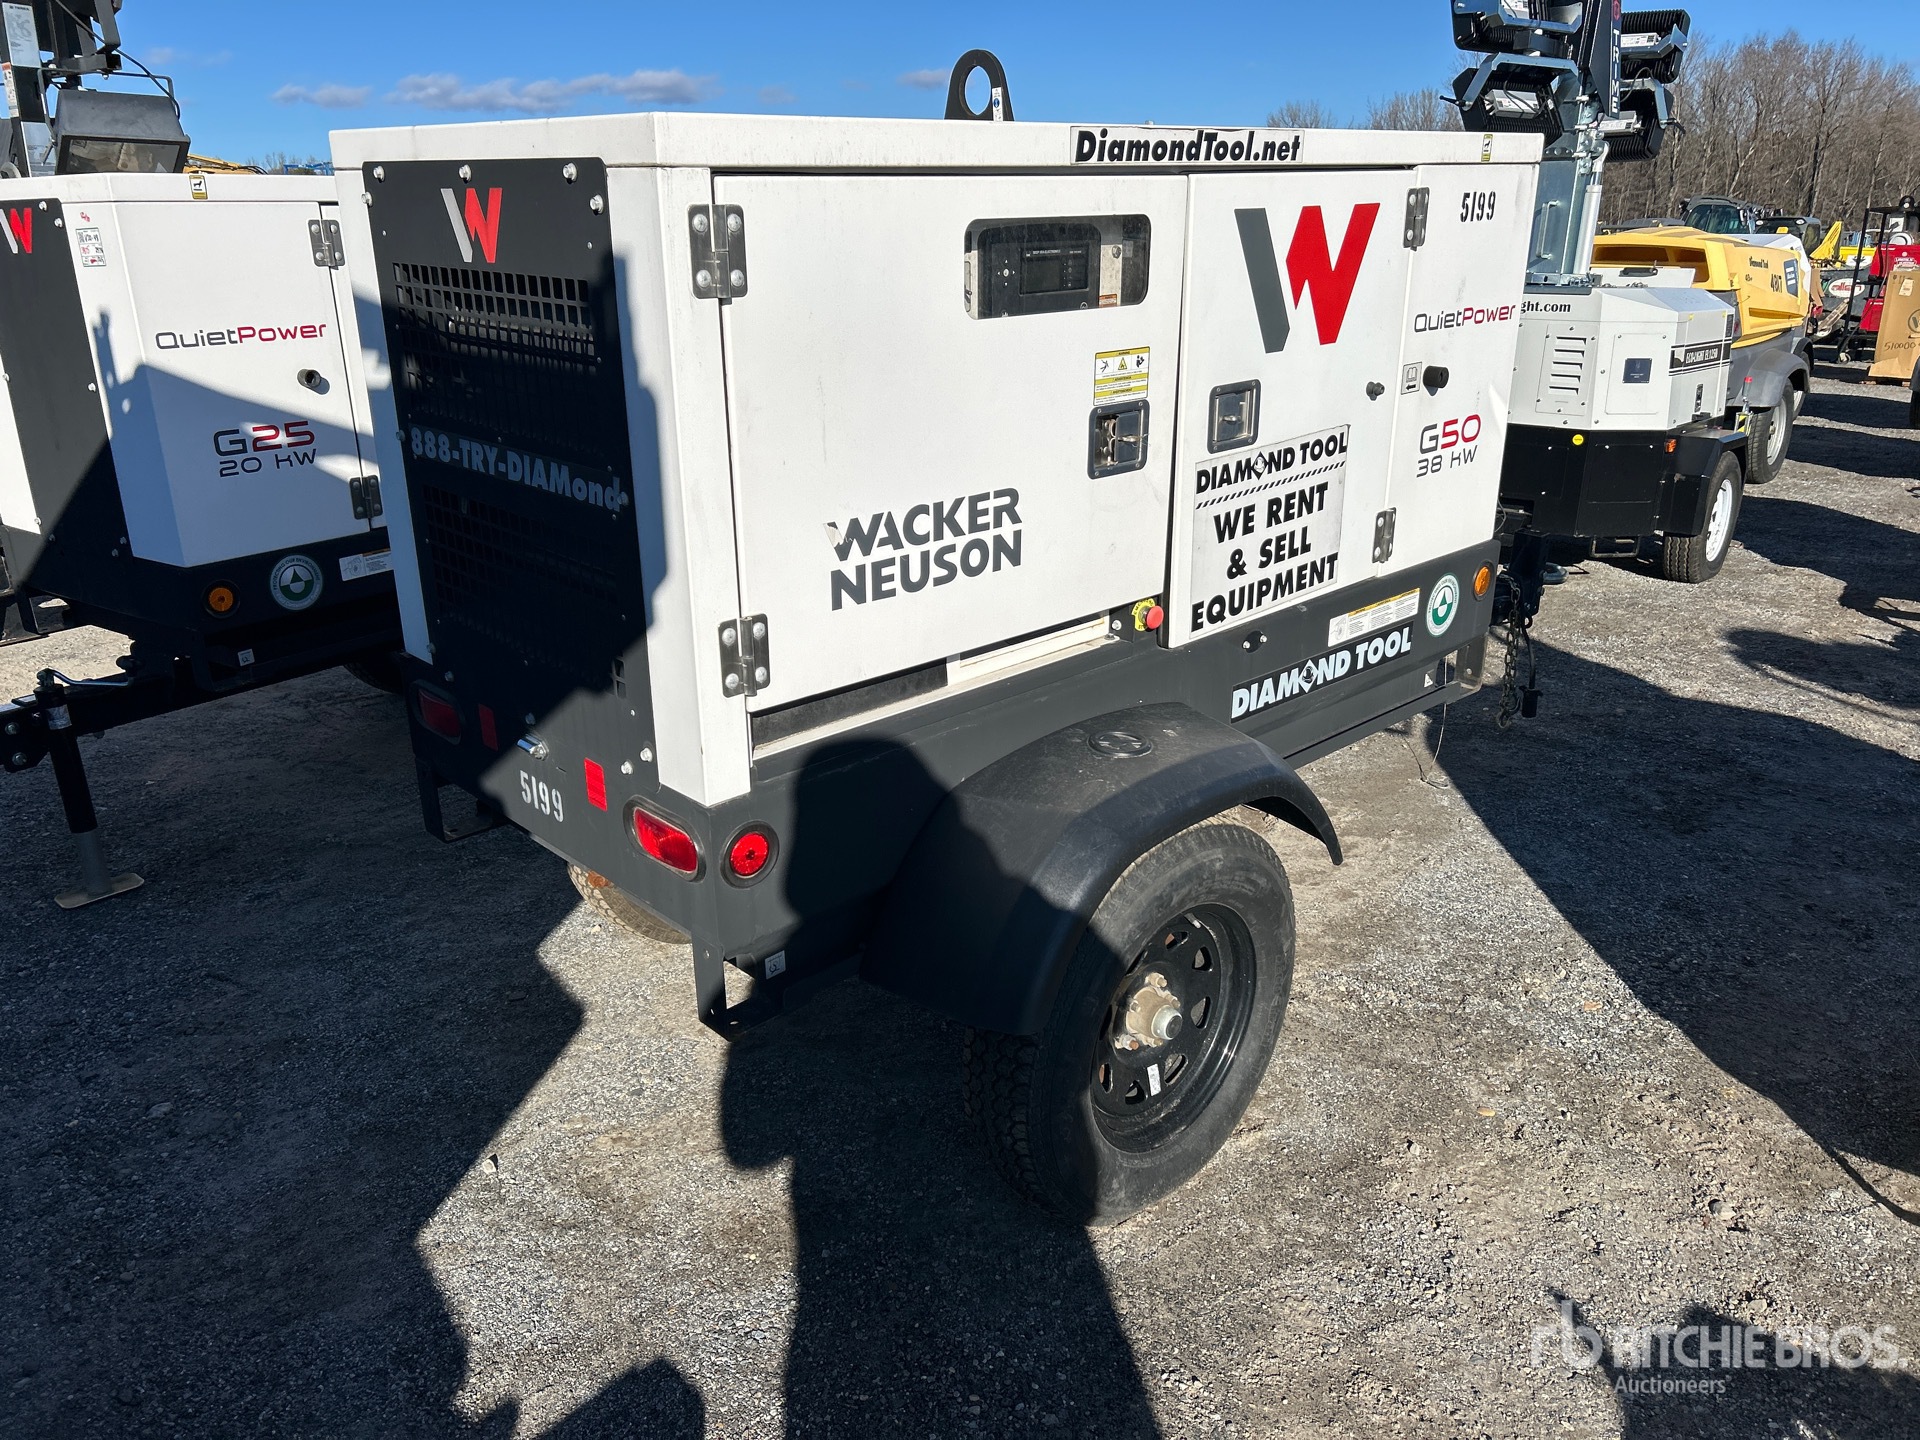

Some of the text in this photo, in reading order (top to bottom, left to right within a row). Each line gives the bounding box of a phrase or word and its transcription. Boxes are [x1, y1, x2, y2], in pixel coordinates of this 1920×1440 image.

[1611, 29, 1620, 113] TRIME
[1075, 128, 1301, 163] DiamondTool.net
[1460, 191, 1496, 222] 5199
[156, 322, 327, 350] QuietPower
[1414, 304, 1517, 333] QuietPower
[214, 420, 316, 457] G25
[1300, 432, 1348, 465] TOOL
[1420, 414, 1481, 454] G50
[219, 457, 262, 477] 20
[1416, 455, 1443, 478] 38
[825, 487, 1023, 561] WACKER
[1213, 481, 1329, 544] WE RENT
[831, 530, 1023, 611] NEUSON
[1226, 526, 1311, 580] & SELL
[1191, 552, 1339, 632] EQUIPMENT
[1355, 627, 1412, 670] TOOL
[520, 770, 564, 823] 5199
